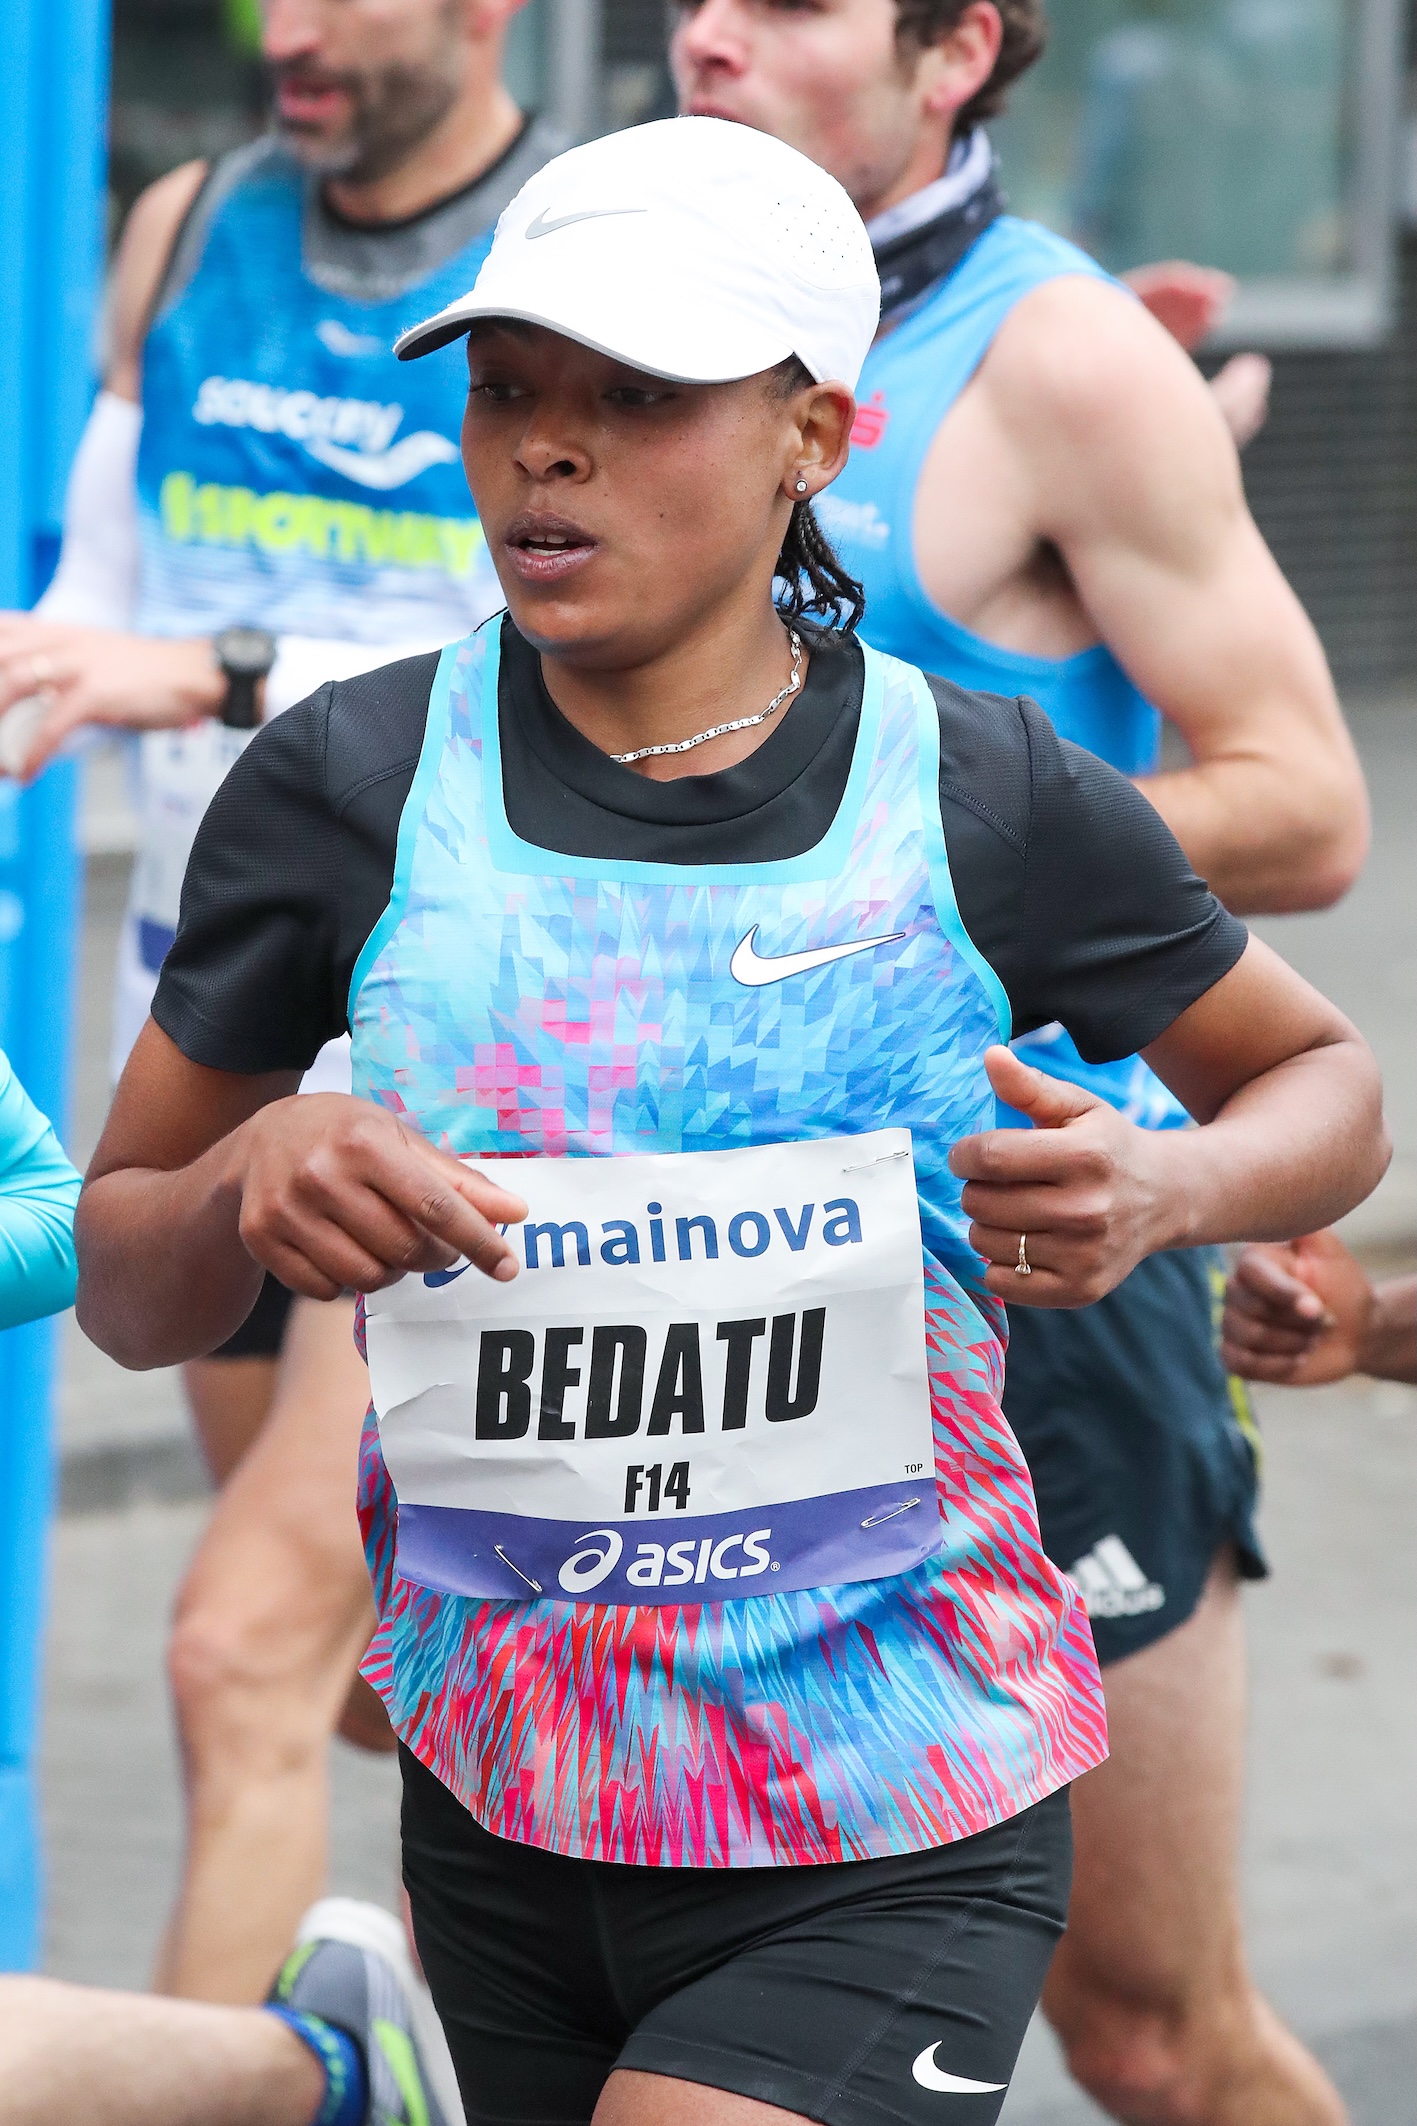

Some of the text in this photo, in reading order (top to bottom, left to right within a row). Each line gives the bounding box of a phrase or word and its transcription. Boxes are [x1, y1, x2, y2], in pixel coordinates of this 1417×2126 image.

[524, 1197, 863, 1269] mainova
[475, 1307, 827, 1441] BEDATU
[623, 1461, 691, 1513] F14
[904, 1462, 924, 1474] TOP
[626, 1528, 771, 1586] asics
